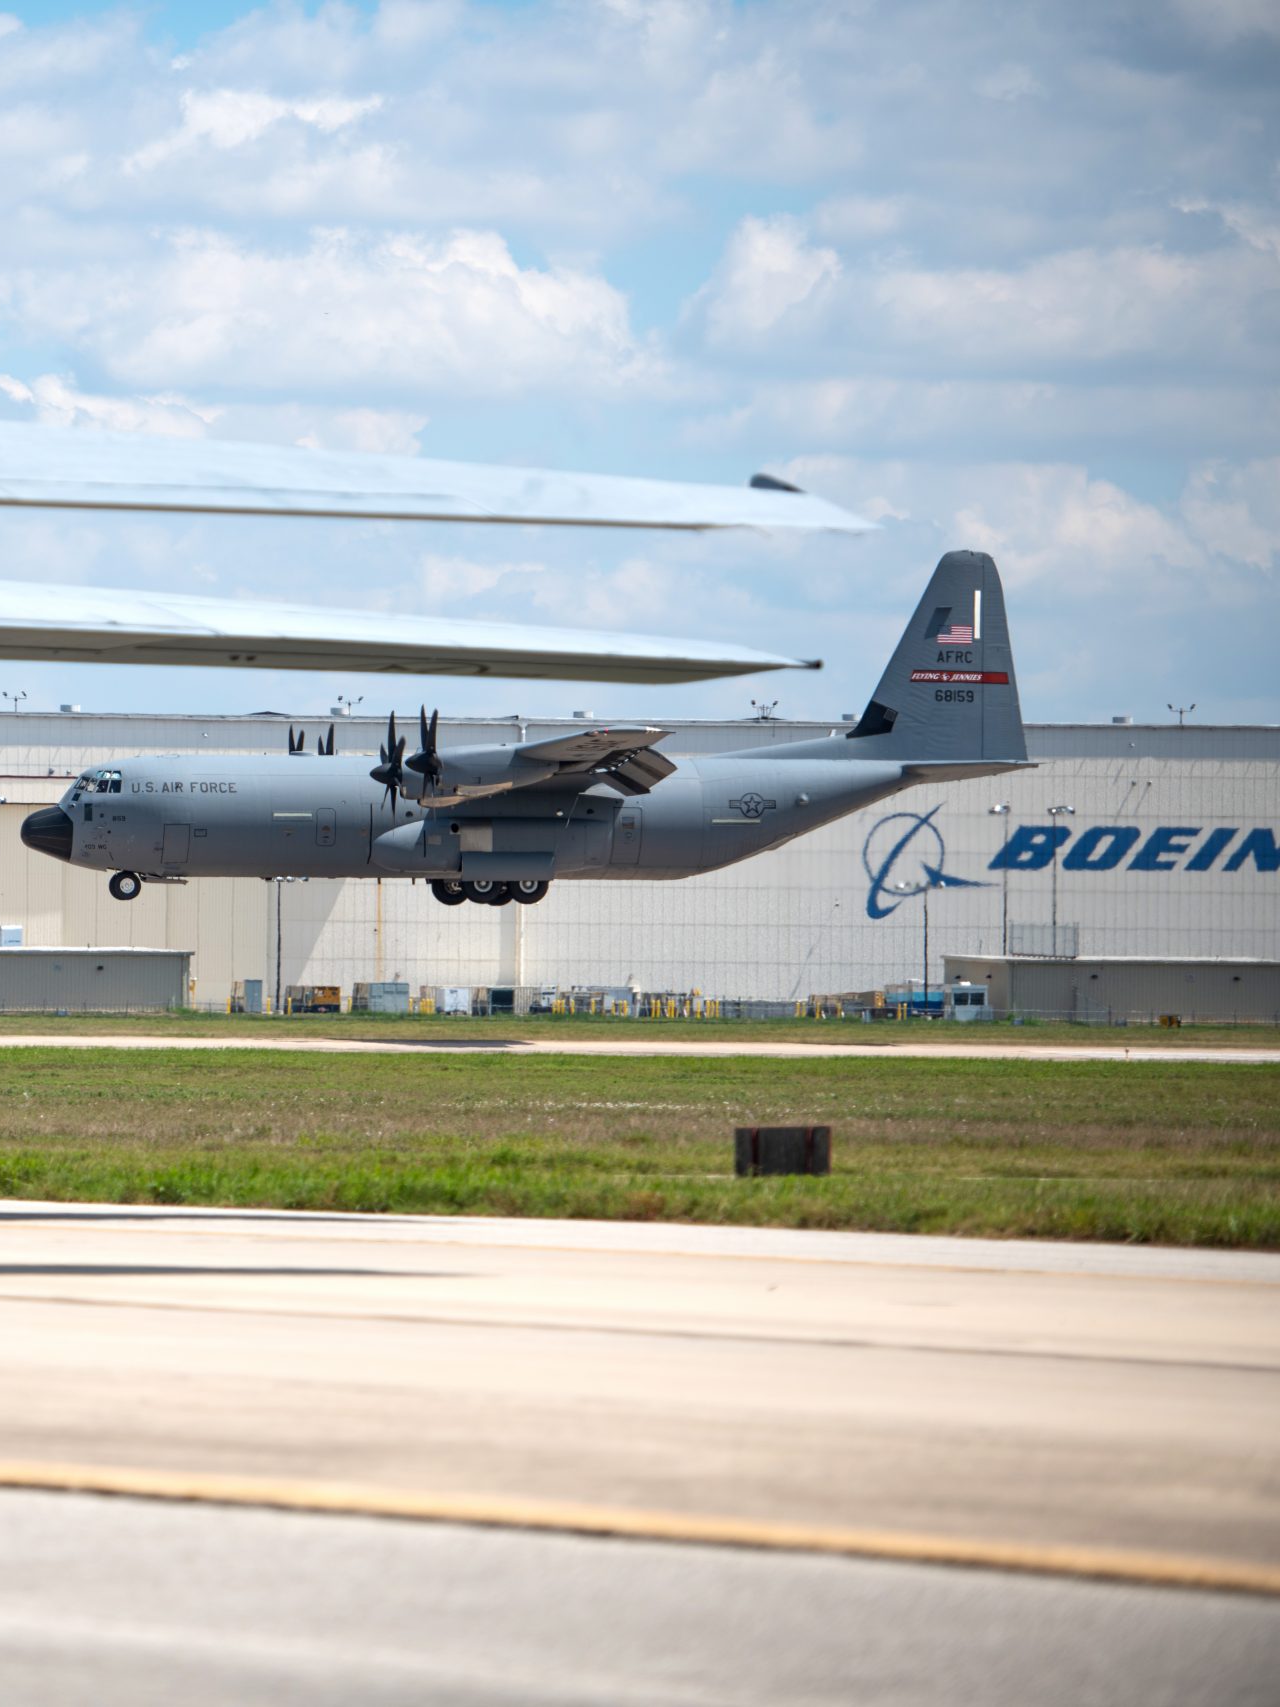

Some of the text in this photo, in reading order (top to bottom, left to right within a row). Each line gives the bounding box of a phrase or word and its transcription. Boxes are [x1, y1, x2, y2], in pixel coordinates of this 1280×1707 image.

[936, 650, 973, 664] AFRC
[911, 672, 983, 682] FLYING JENNIES
[935, 689, 974, 703] 68159
[131, 781, 238, 793] U.S. AIR FORCE
